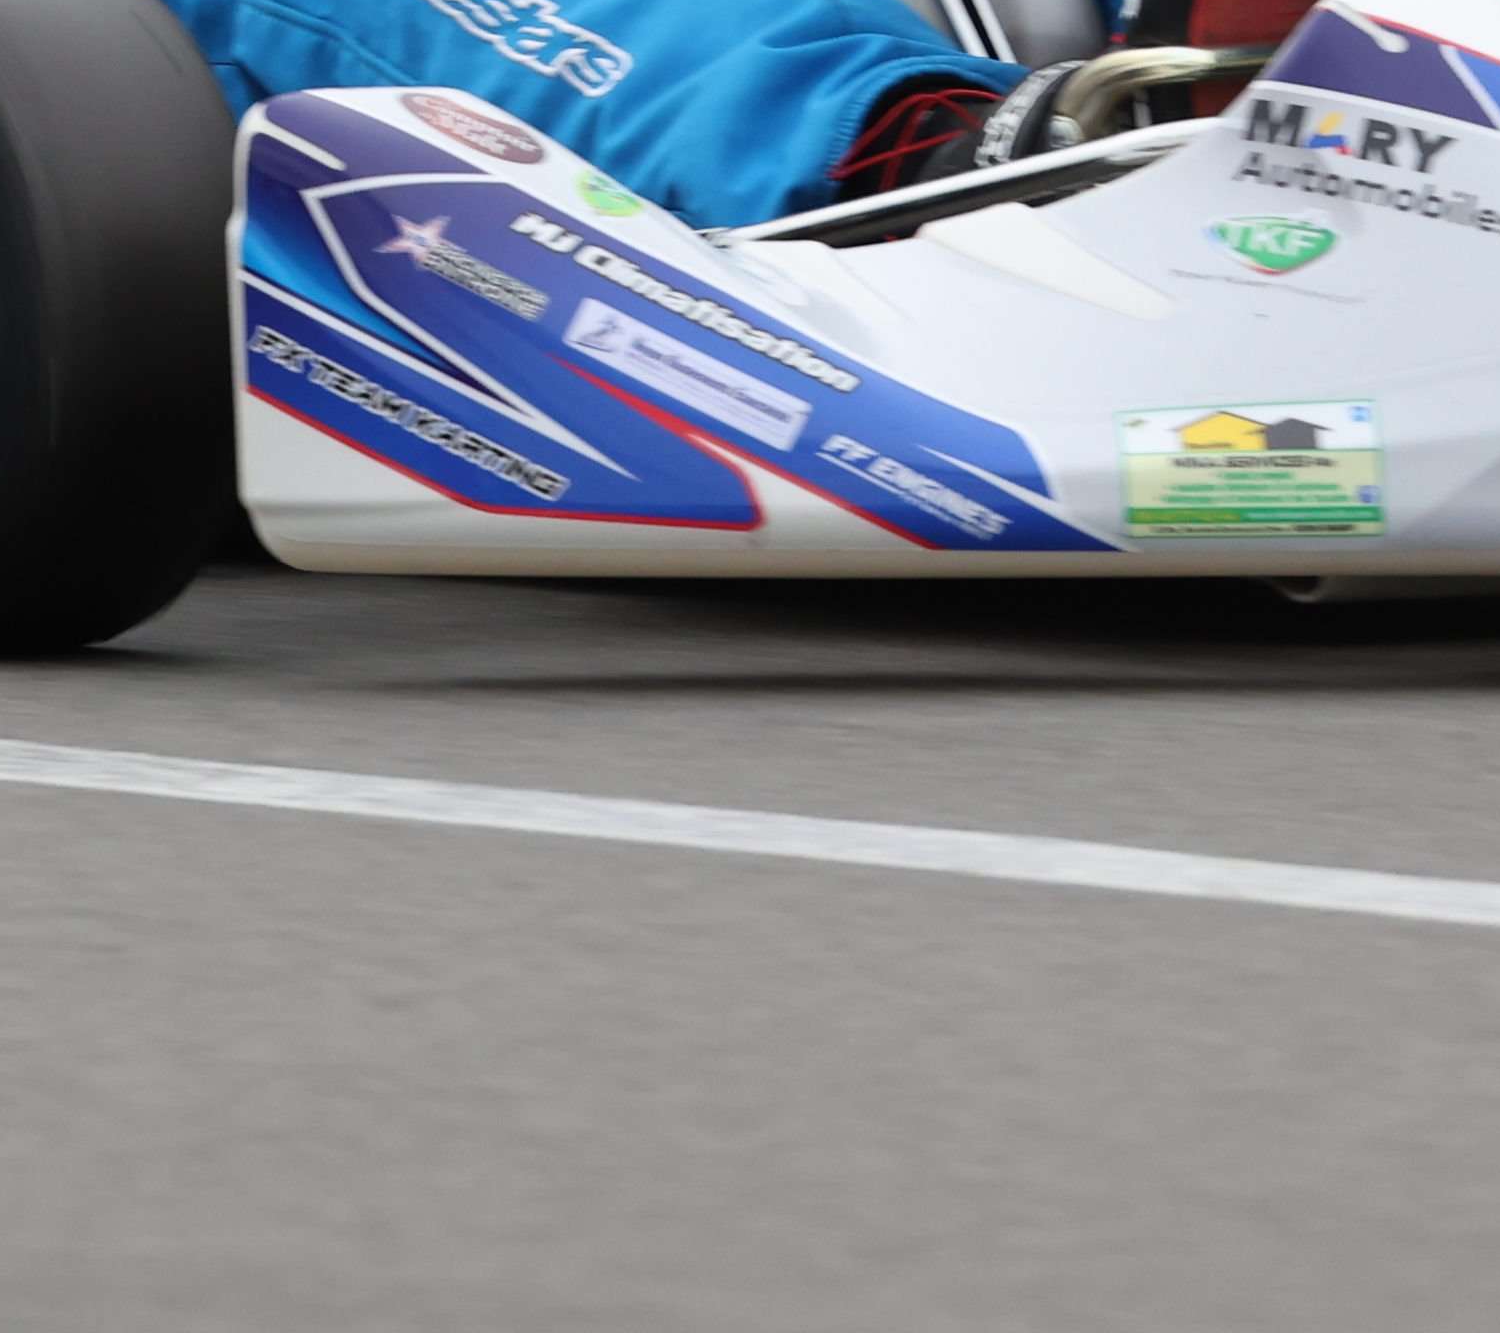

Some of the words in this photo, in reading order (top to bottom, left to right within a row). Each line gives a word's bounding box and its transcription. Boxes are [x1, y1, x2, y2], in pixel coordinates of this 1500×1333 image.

[1246, 98, 1457, 172] MARY
[306, 351, 410, 424] TEAM
[400, 399, 572, 502] KARTING
